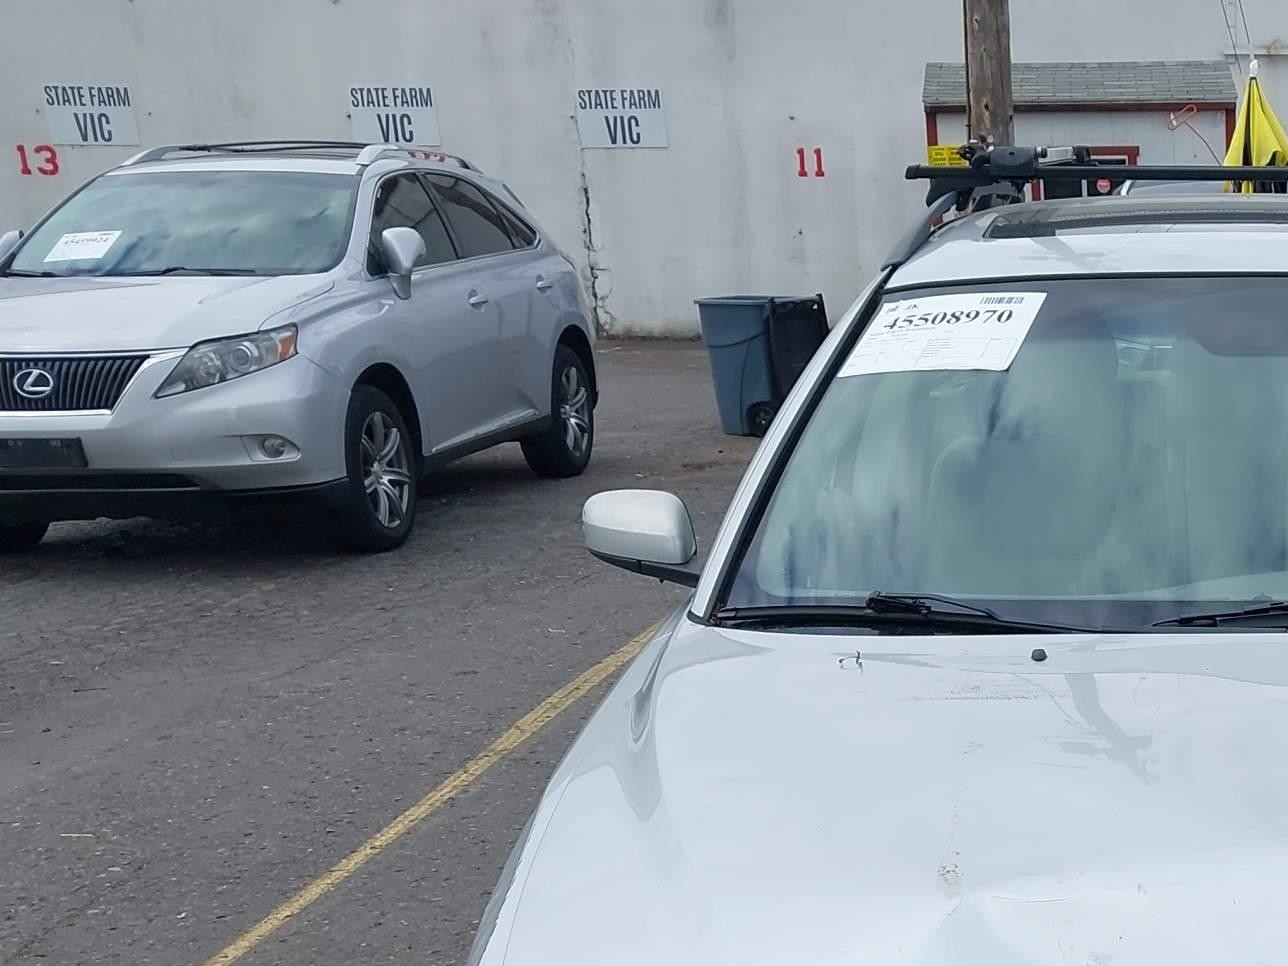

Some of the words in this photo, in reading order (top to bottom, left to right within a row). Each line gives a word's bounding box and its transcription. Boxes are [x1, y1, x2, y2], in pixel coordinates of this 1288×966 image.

[44, 85, 87, 107] STATE
[88, 86, 131, 107] FARM
[350, 87, 390, 108] STATE
[392, 87, 433, 108] FARM
[578, 89, 618, 110] STATE
[620, 89, 661, 110] FARM
[73, 112, 112, 142] VIC
[376, 113, 414, 143] VIC
[604, 115, 641, 145] VIC
[16, 144, 59, 176] 13
[796, 147, 825, 177] 11
[883, 309, 1013, 329] 45508970
